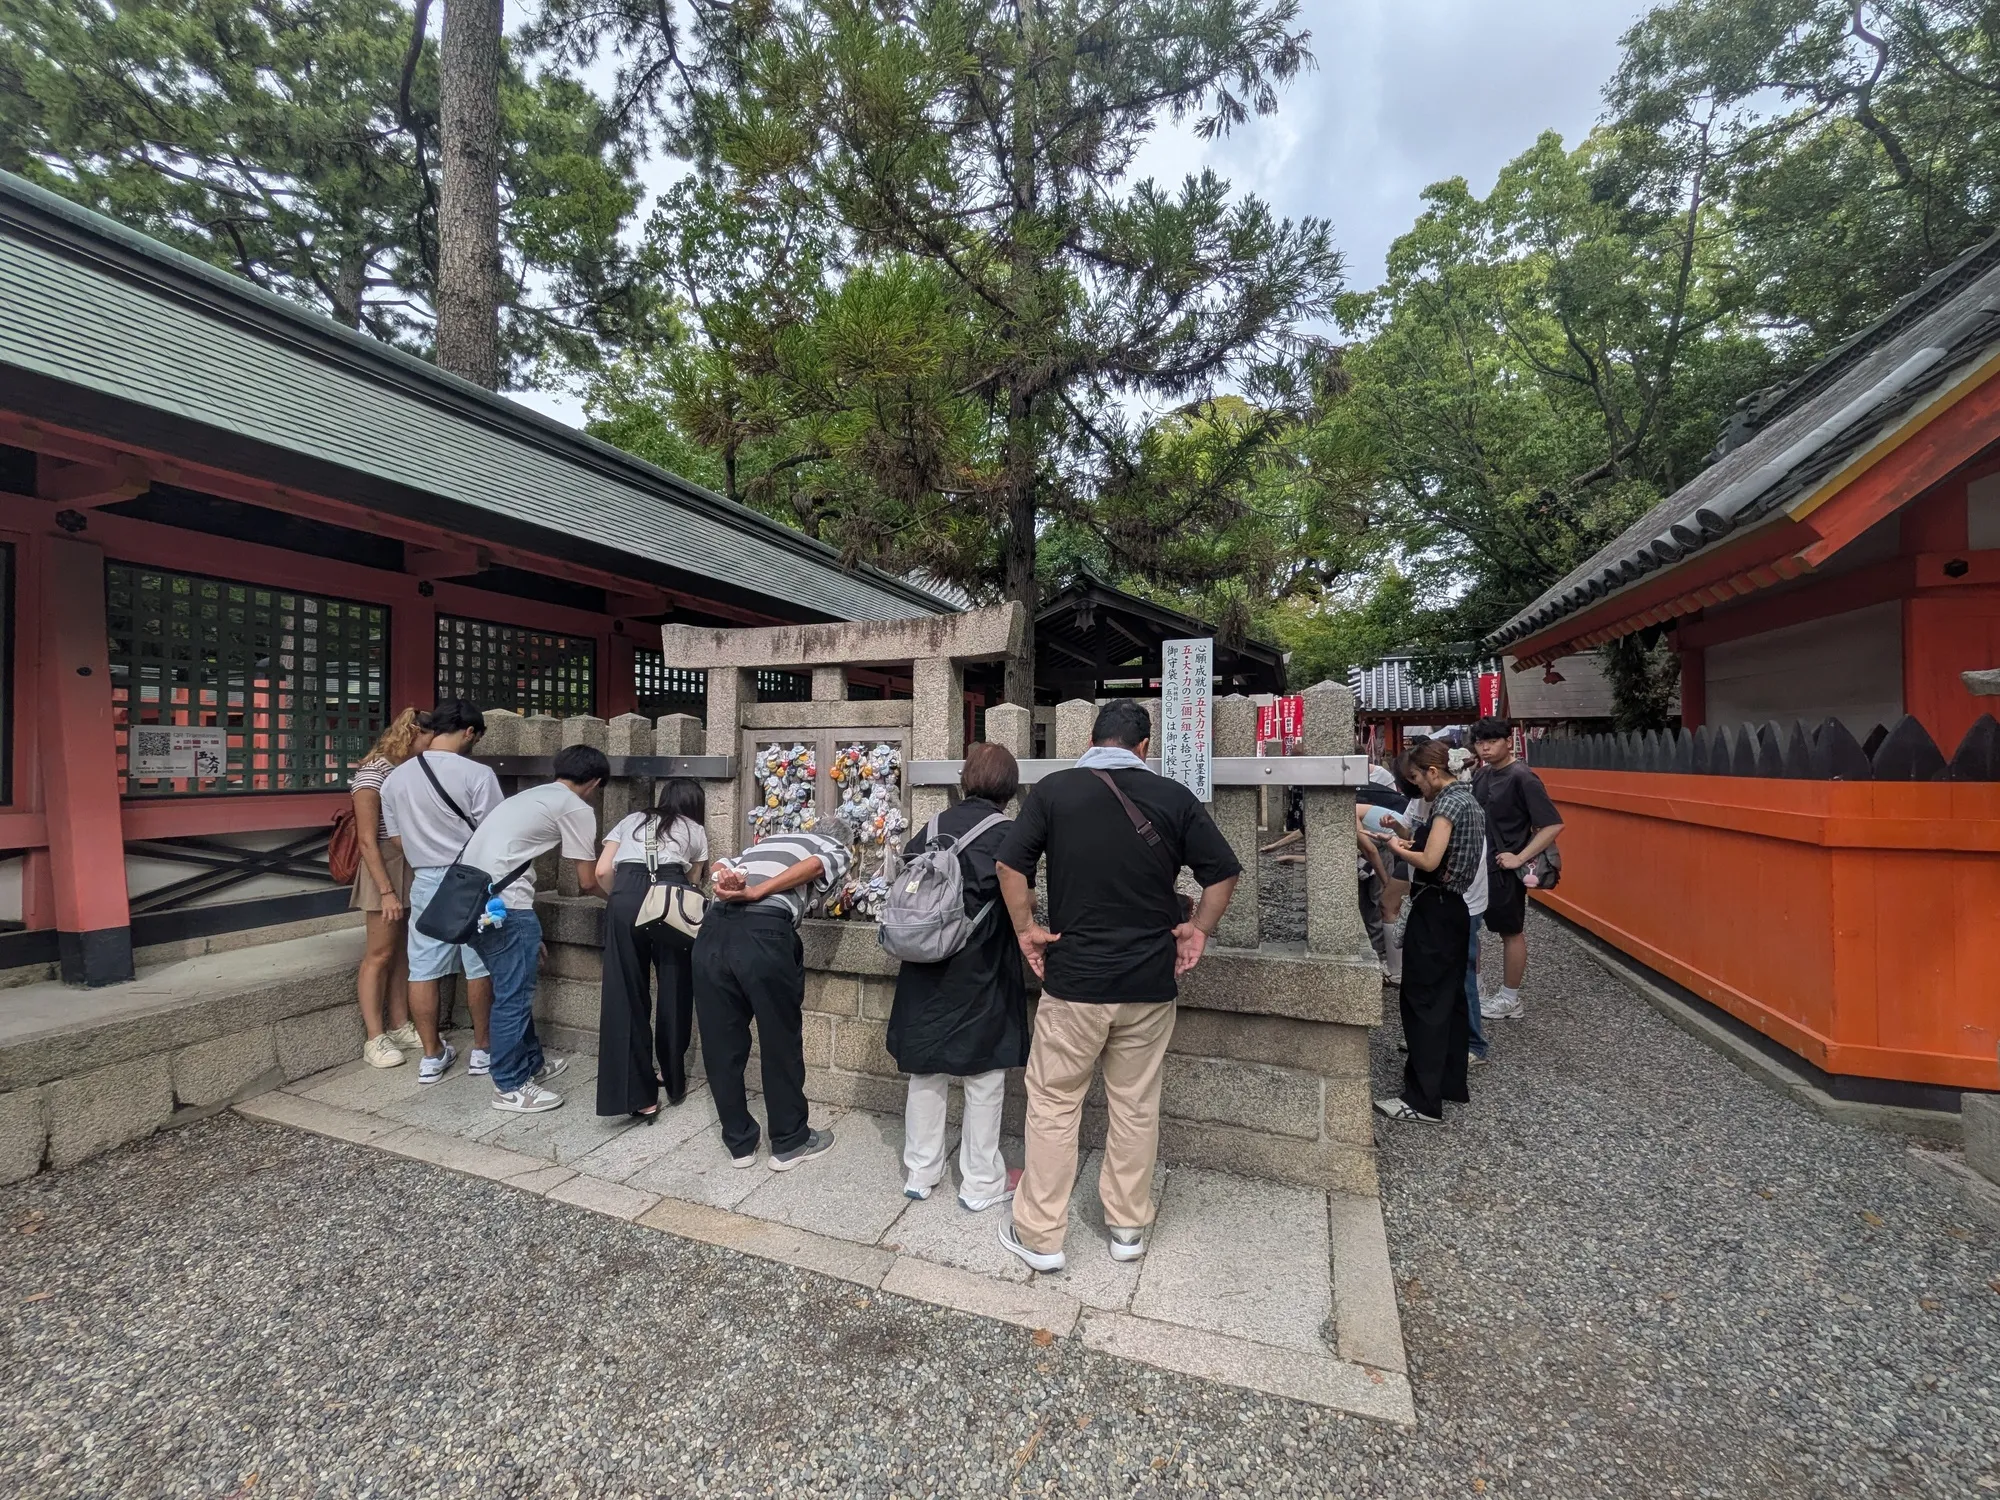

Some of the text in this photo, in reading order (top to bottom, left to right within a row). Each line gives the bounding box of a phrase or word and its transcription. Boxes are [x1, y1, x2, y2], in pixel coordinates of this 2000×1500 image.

[1194, 644, 1207, 797] 心願成就の五大力石守は墨書の
